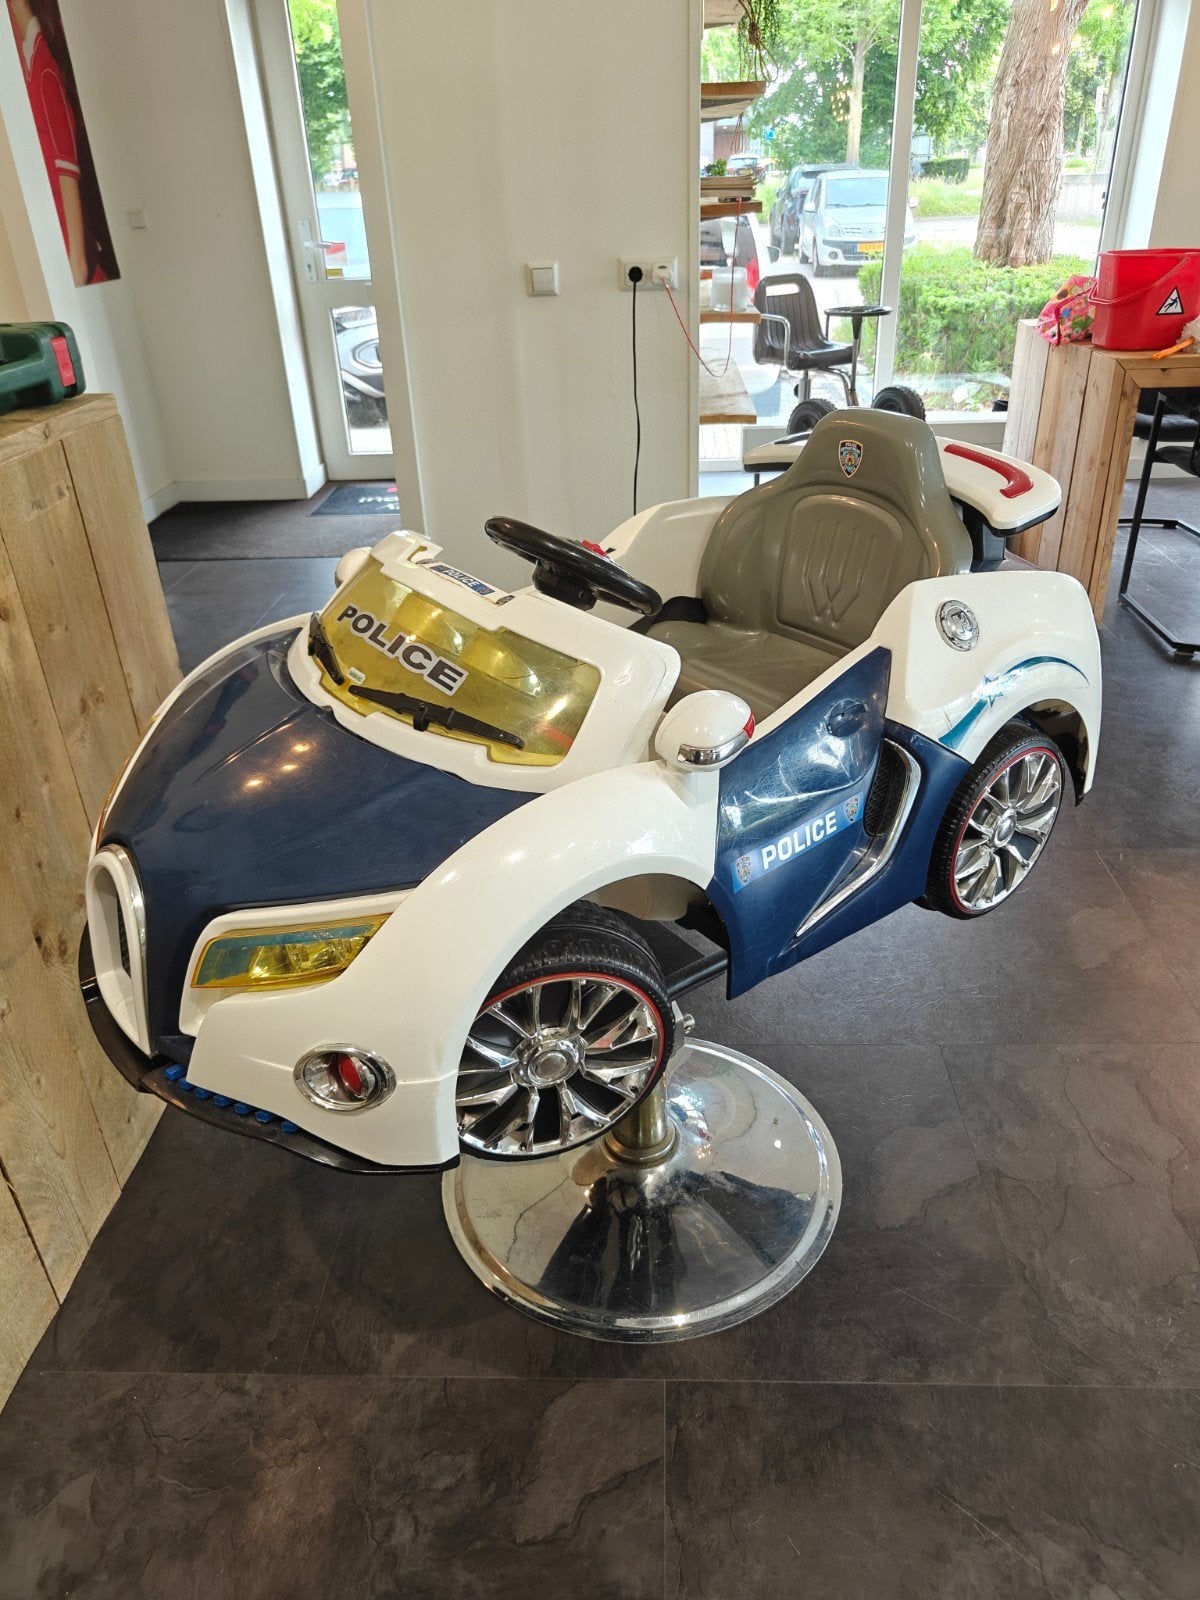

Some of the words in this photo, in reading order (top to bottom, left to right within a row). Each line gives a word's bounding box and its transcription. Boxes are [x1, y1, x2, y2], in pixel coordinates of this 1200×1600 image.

[442, 568, 481, 588] POLICE
[336, 604, 465, 693] POLICE
[761, 810, 837, 871] POLICE
